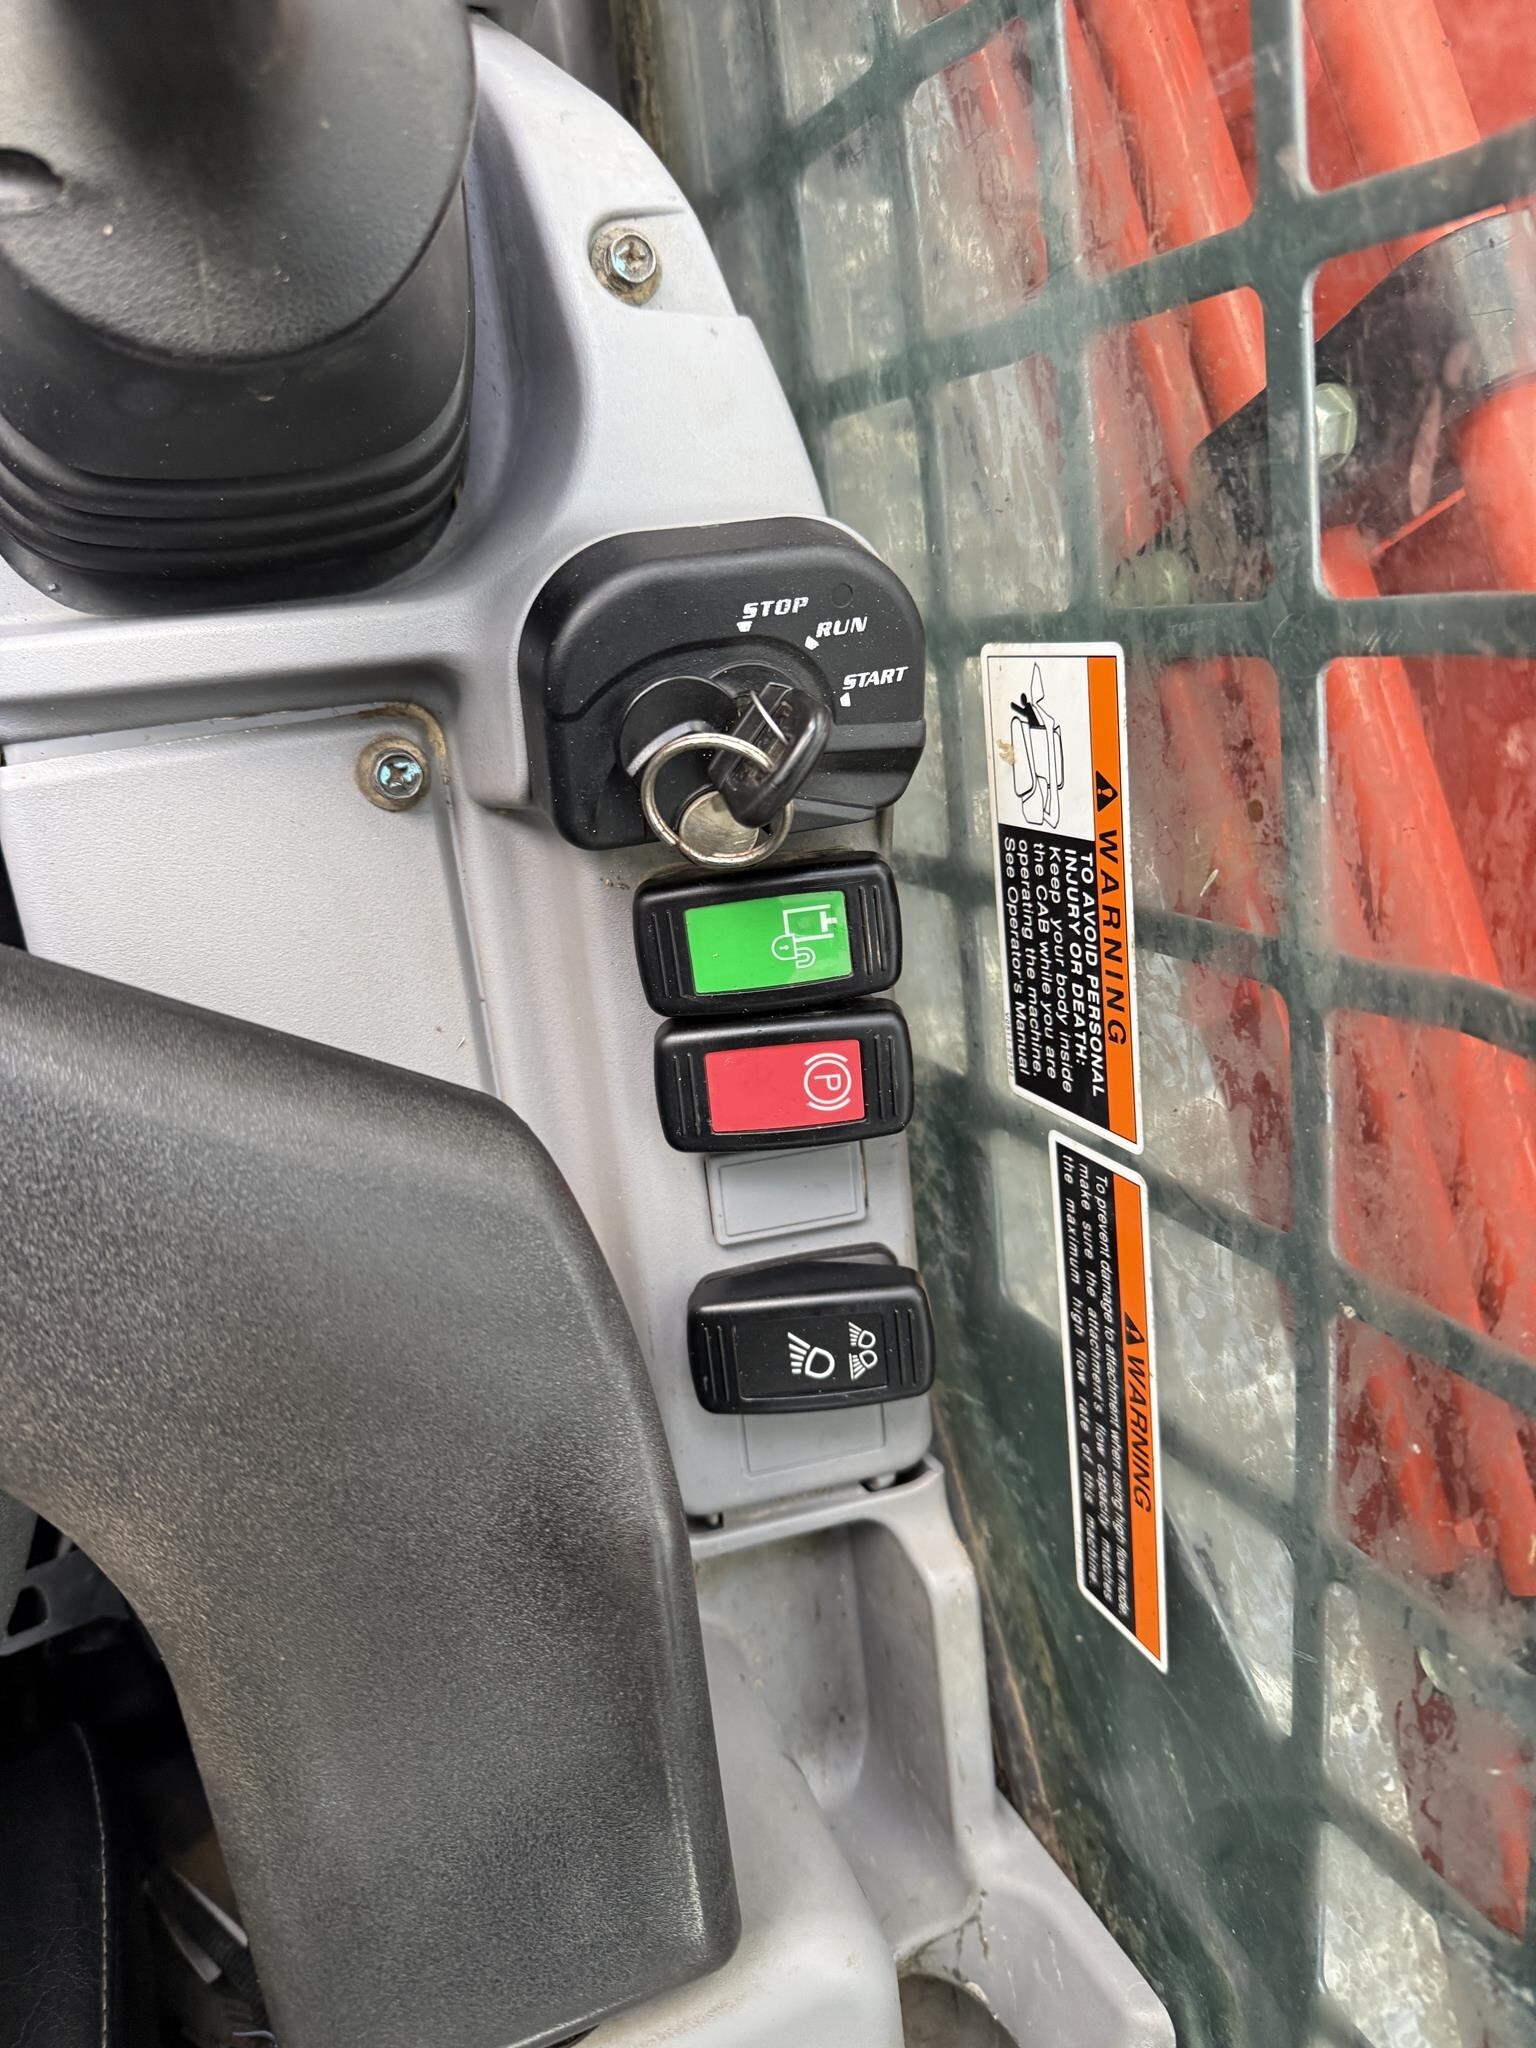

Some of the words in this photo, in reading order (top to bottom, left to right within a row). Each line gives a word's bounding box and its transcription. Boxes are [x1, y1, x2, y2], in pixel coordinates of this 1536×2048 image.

[742, 596, 809, 619] STOP
[816, 616, 868, 638] RUN
[842, 666, 909, 690] START
[1004, 836, 1016, 879] See
[1033, 842, 1046, 877] the
[1049, 846, 1062, 904] Keep
[1080, 853, 1094, 884] TO
[1016, 839, 1034, 940] operating
[1035, 884, 1050, 934] CAB
[1065, 849, 1081, 936] INJURY
[1006, 886, 1025, 994] Operator's
[1050, 918, 1066, 967] your
[1082, 892, 1098, 967] AVOID
[1099, 829, 1127, 1045] WARNING
[1025, 947, 1037, 980] the
[1039, 941, 1053, 994] while
[1069, 942, 1083, 976] OR
[1040, 1001, 1054, 1040] you
[1055, 973, 1070, 1025] body
[1014, 1001, 1030, 1076] Manual
[1027, 986, 1042, 1077] machine.
[1071, 982, 1087, 1066] DEATH:
[1086, 974, 1105, 1097] PERSONAL
[813, 1073, 841, 1091] P
[1045, 1045, 1057, 1079] are
[1059, 1031, 1074, 1093] inside
[1062, 1154, 1075, 1184] the
[1079, 1163, 1092, 1211] make
[1095, 1175, 1108, 1195] To
[1065, 1198, 1080, 1285] maximum
[1081, 1221, 1094, 1260] sure
[1094, 1195, 1112, 1260] prevent
[1085, 1269, 1098, 1298] the
[1100, 1260, 1113, 1323] damage
[1070, 1296, 1085, 1337] high
[1104, 1325, 1117, 1342] to
[1075, 1347, 1088, 1387] flow
[1087, 1306, 1104, 1414] attachment's
[1105, 1343, 1120, 1429] attachment
[1078, 1395, 1091, 1433] rate
[1127, 1354, 1152, 1512] WARNING
[1081, 1442, 1095, 1465] of
[1095, 1421, 1107, 1458] flow
[1110, 1428, 1124, 1470] when
[1082, 1471, 1096, 1504] this
[1097, 1463, 1111, 1531] capacity
[1111, 1470, 1126, 1513] using
[1112, 1511, 1127, 1544] high
[1101, 1536, 1114, 1605] matches
[1116, 1543, 1128, 1575] flow
